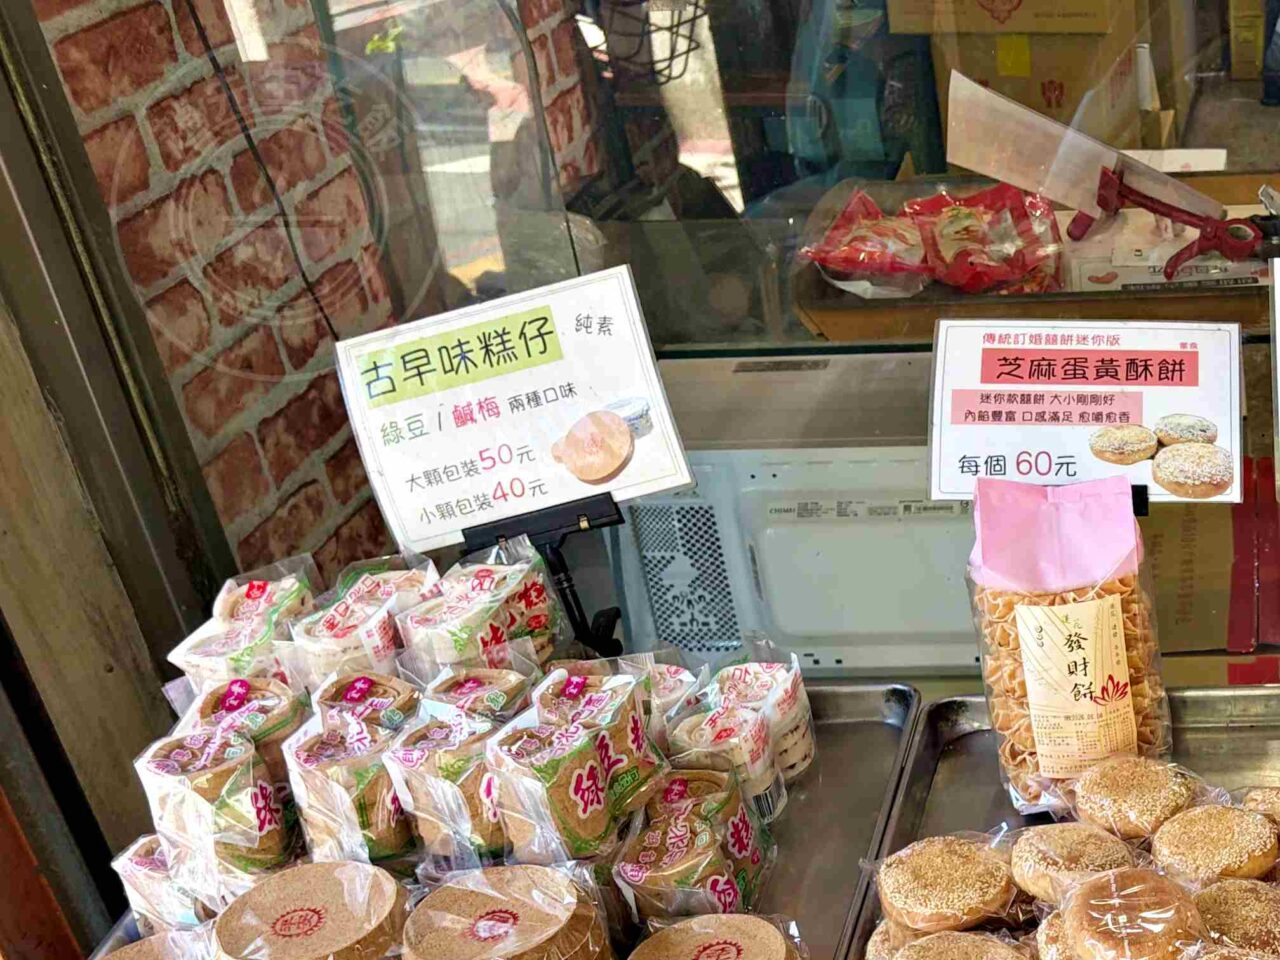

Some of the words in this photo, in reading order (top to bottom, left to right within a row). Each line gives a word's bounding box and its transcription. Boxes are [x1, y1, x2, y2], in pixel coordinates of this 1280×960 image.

[575, 313, 614, 336] 純素
[361, 315, 554, 399] 古早味糕仔
[996, 356, 1186, 382] 芝麻蛋黃酥餅
[380, 414, 429, 447] 綠豆
[452, 396, 501, 428] 鹹梅
[508, 382, 577, 414] 兩種口味
[964, 410, 1016, 422] 內餡豐富
[1022, 411, 1074, 423] 口感滿足
[1050, 394, 1116, 406] 大小剛剛好
[406, 443, 536, 493] 大顆包裝50元
[420, 477, 548, 525] 小顆包裝40元
[1064, 632, 1096, 702] 發財餅
